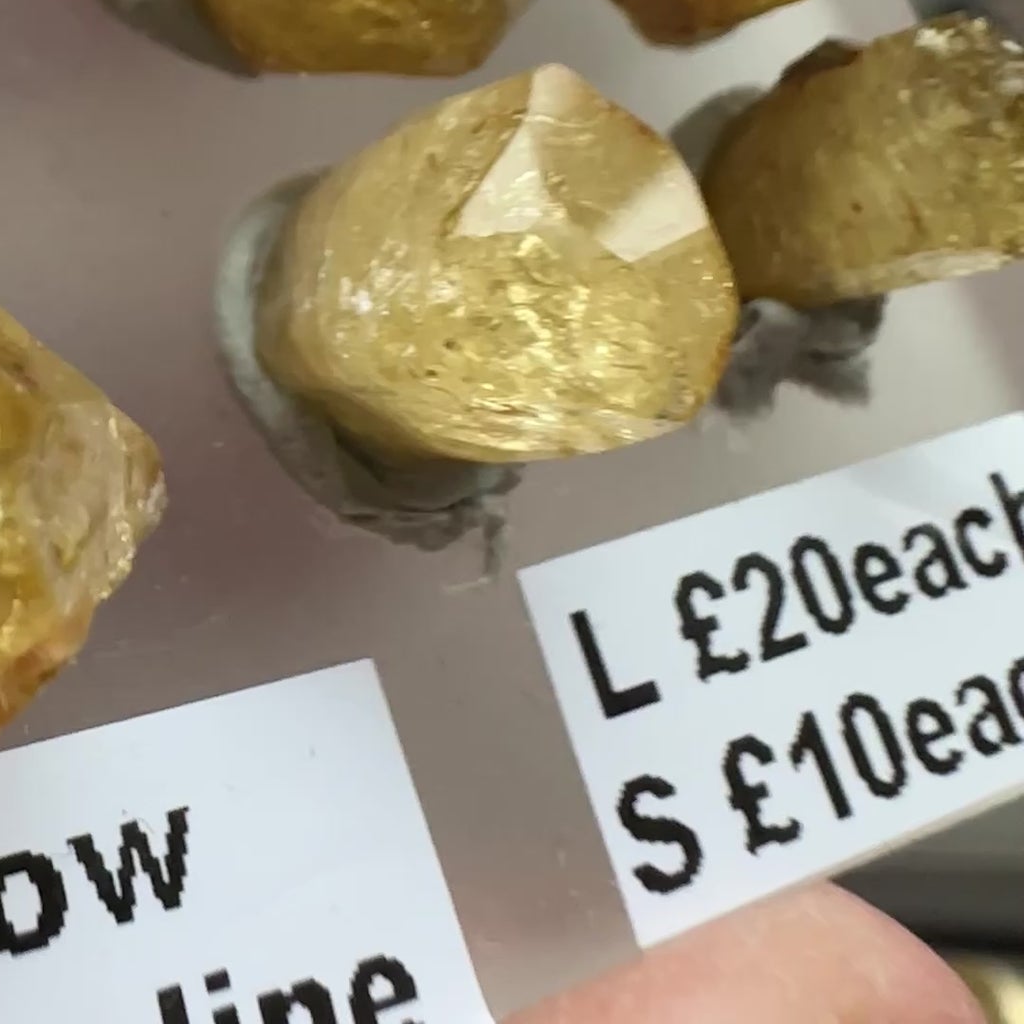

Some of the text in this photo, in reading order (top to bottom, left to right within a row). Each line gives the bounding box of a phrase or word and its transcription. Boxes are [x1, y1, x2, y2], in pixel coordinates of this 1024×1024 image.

[570, 609, 662, 719] L
[615, 657, 1024, 895] S £10ea
